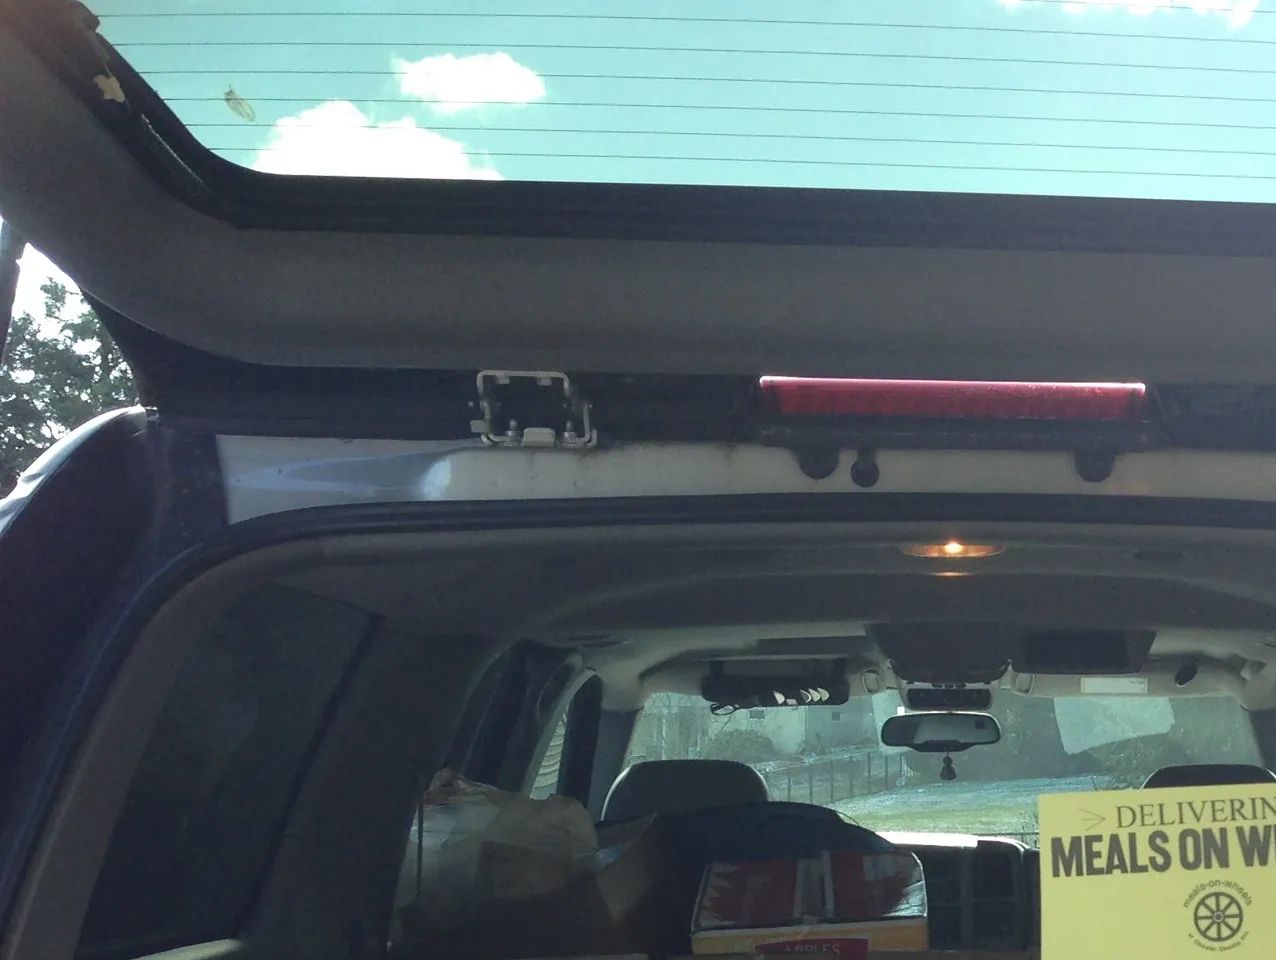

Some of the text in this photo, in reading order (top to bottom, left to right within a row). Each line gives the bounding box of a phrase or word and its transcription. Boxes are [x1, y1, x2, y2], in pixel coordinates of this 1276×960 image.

[1051, 827, 1171, 878] MEALS
[1179, 826, 1228, 871] ON
[1183, 879, 1252, 909] meals-on-wheels
